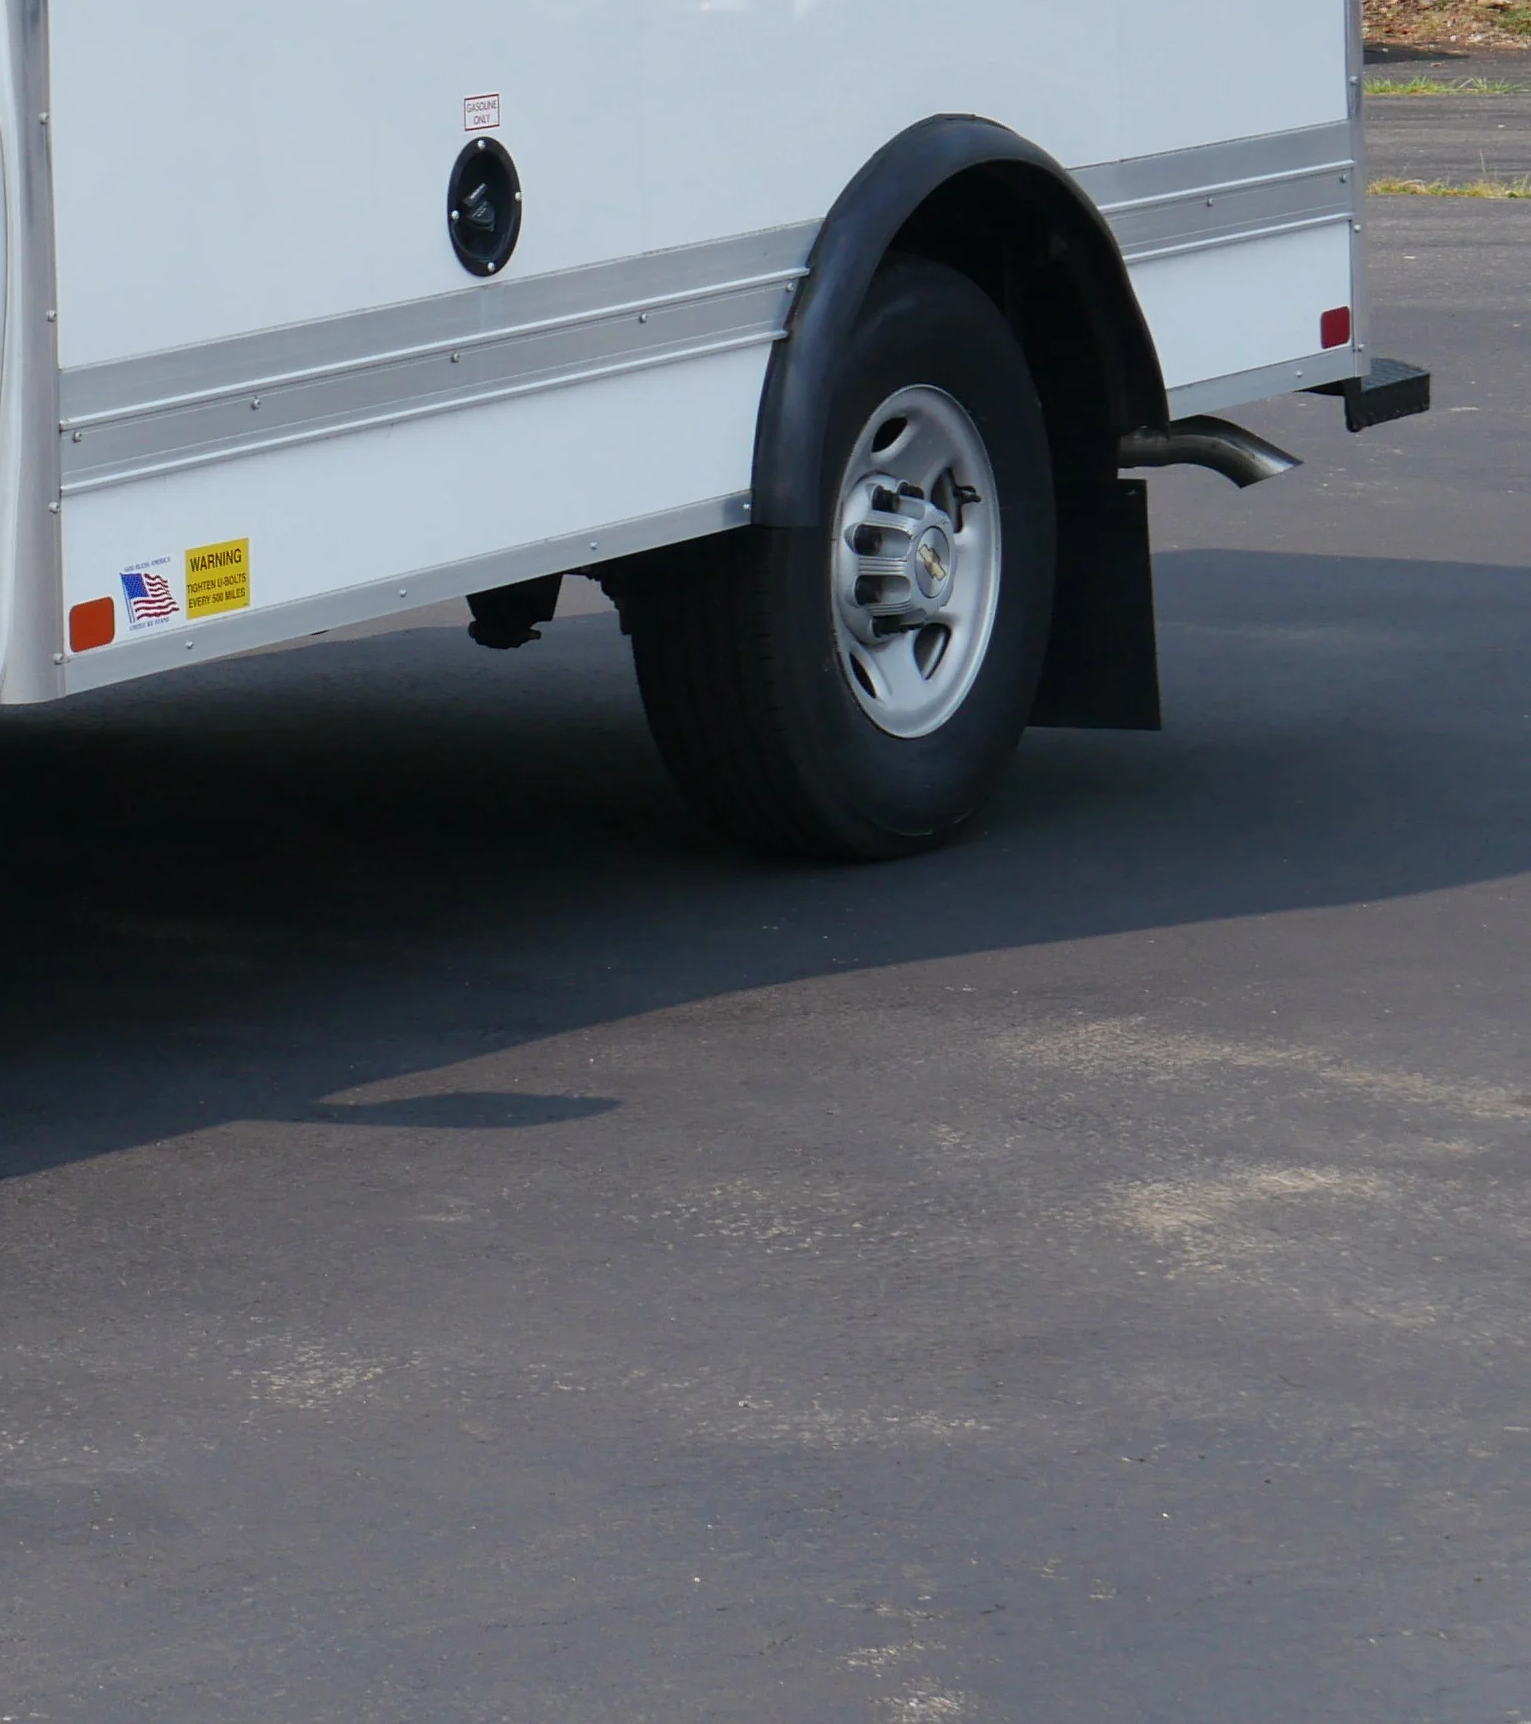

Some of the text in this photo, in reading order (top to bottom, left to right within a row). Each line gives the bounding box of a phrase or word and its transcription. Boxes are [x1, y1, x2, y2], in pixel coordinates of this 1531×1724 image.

[466, 99, 498, 113] GASOLINE
[473, 114, 491, 125] ONLY
[189, 548, 242, 572] WARNING
[186, 572, 247, 594] TIGHTEN U-BOLTS
[188, 587, 246, 609] EVERY 500 MILES
